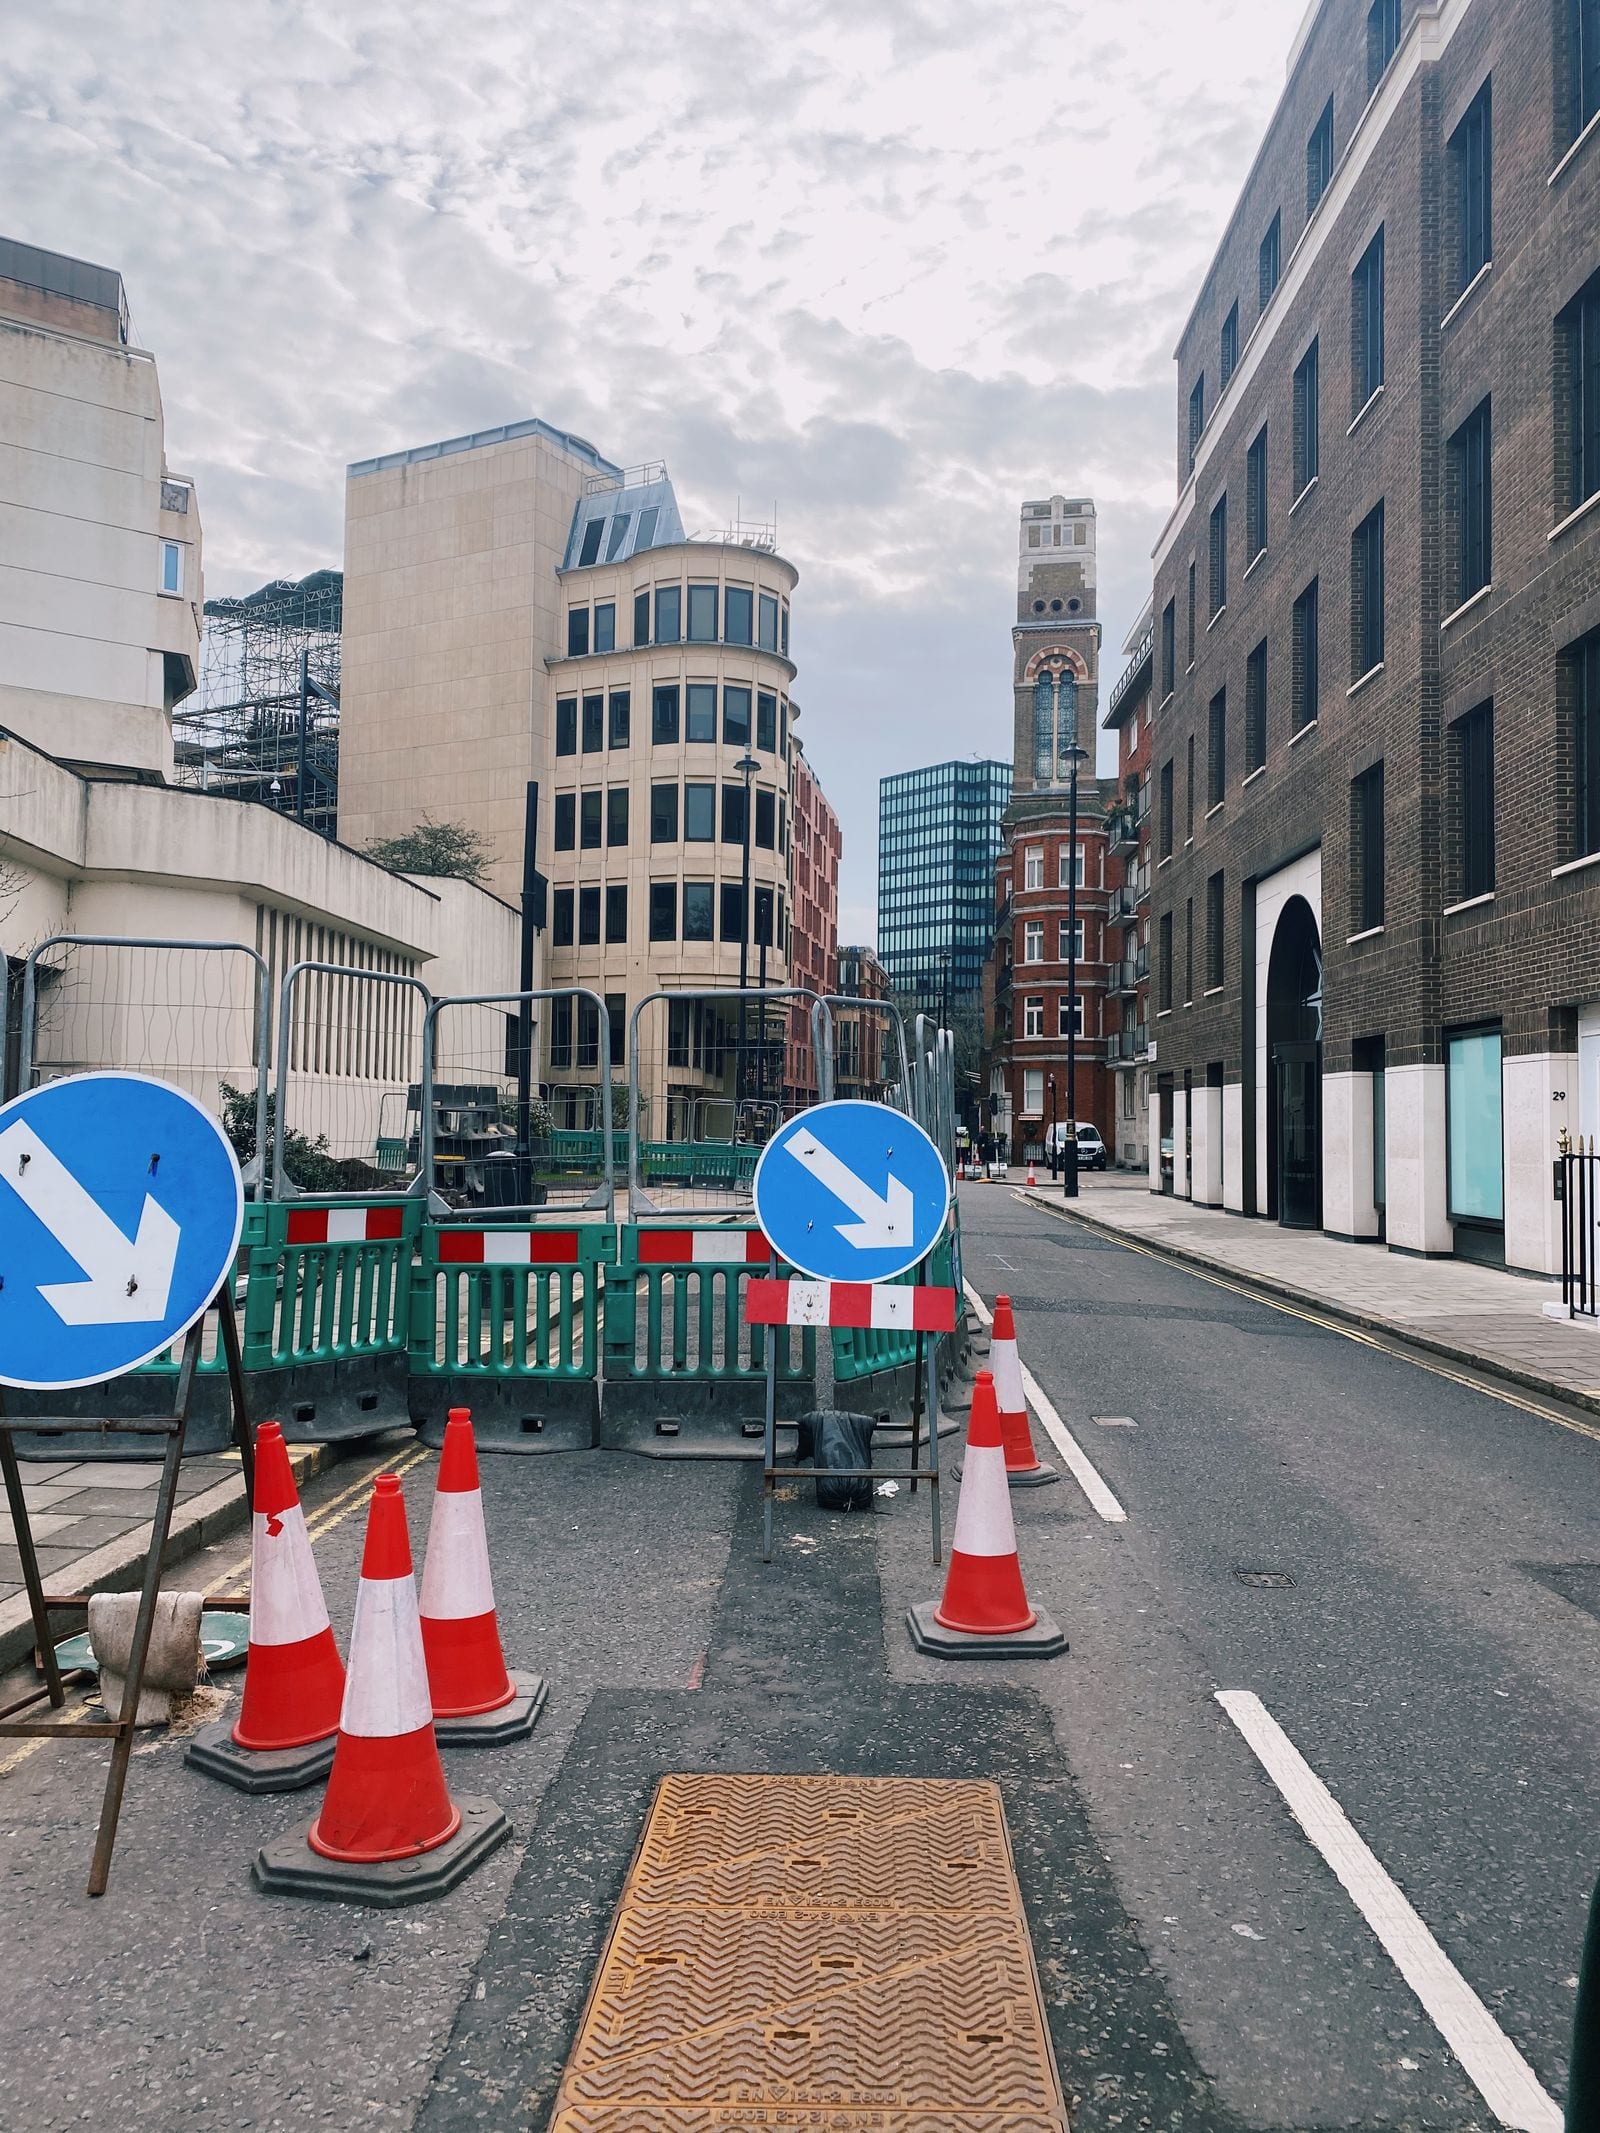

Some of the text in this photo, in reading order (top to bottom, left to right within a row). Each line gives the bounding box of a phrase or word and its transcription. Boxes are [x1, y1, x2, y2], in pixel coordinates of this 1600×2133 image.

[1553, 1091, 1565, 1100] 29
[854, 1898, 891, 1907] E600
[606, 1973, 625, 1990] BT
[1013, 2003, 1032, 2021] BT
[737, 2089, 897, 2104] EN 124-2 E600
